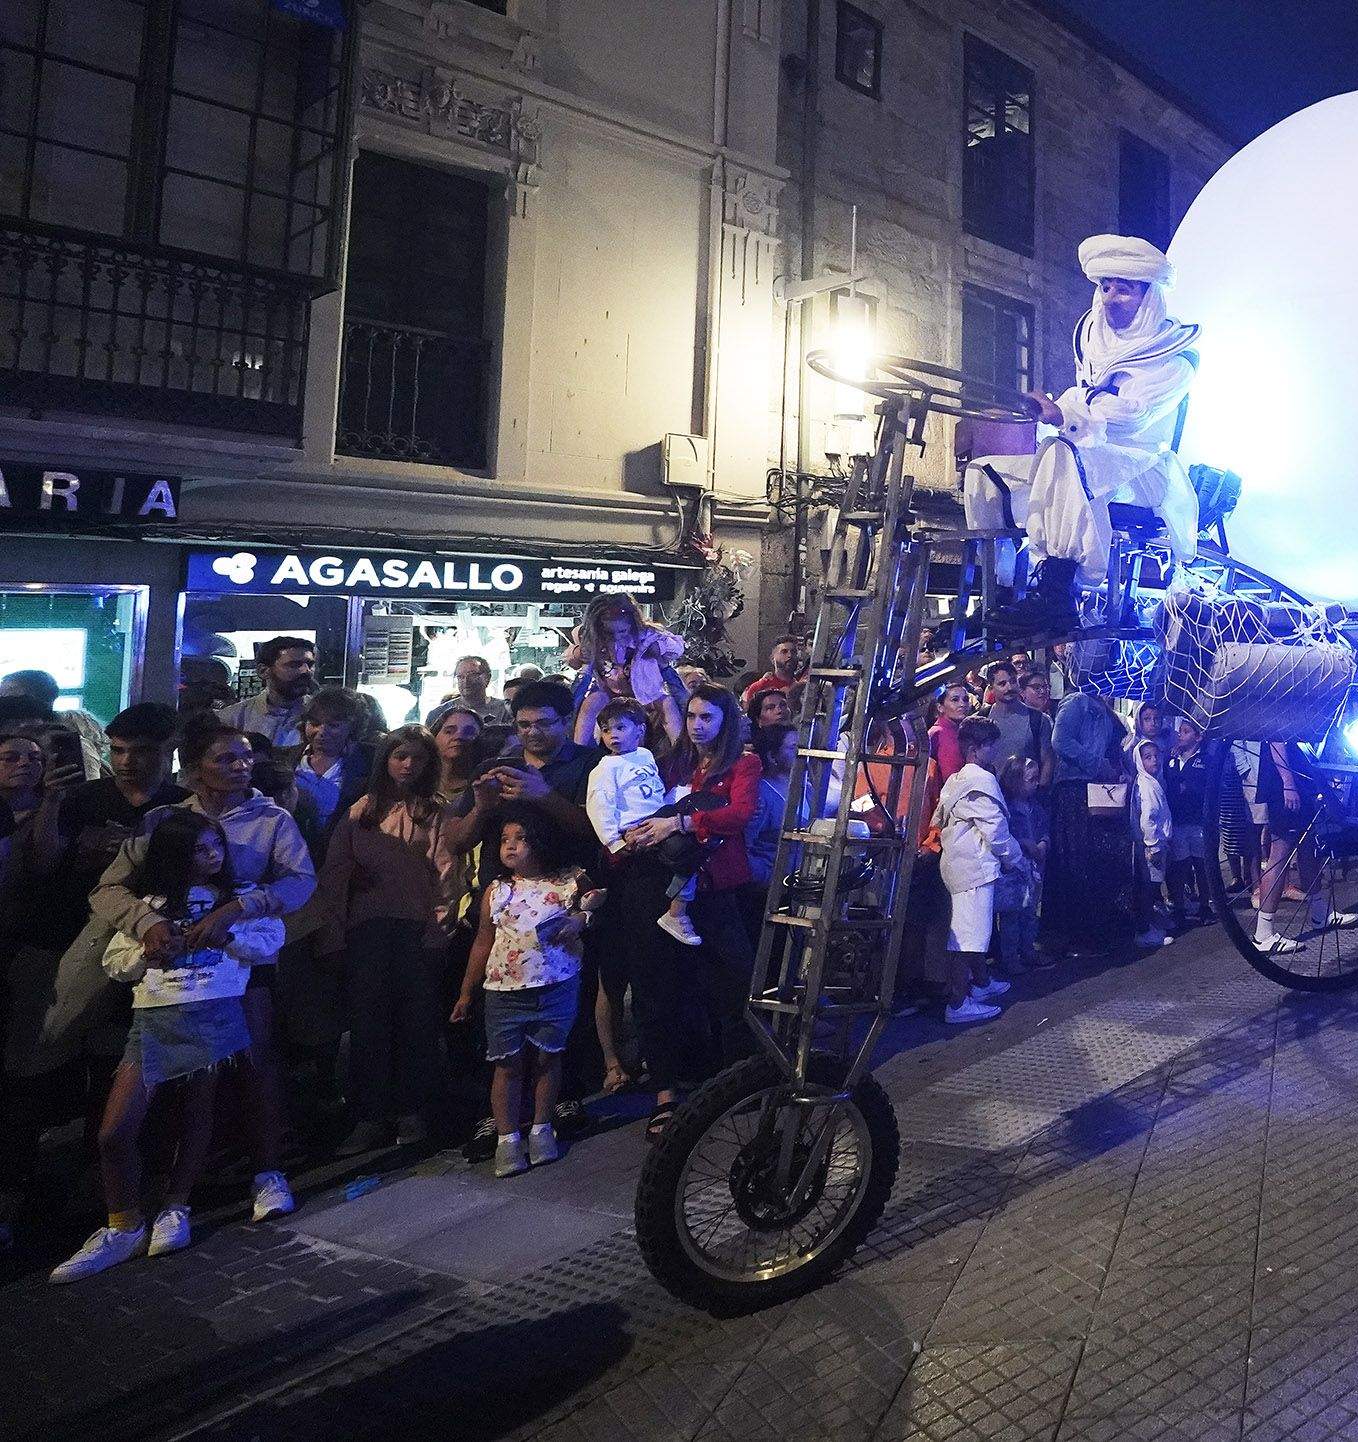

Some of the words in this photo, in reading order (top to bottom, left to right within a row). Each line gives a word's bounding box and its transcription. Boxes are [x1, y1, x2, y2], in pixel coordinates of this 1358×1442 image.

[270, 555, 523, 591] AGASALLO
[612, 569, 655, 583] galega
[541, 581, 580, 593] regalo
